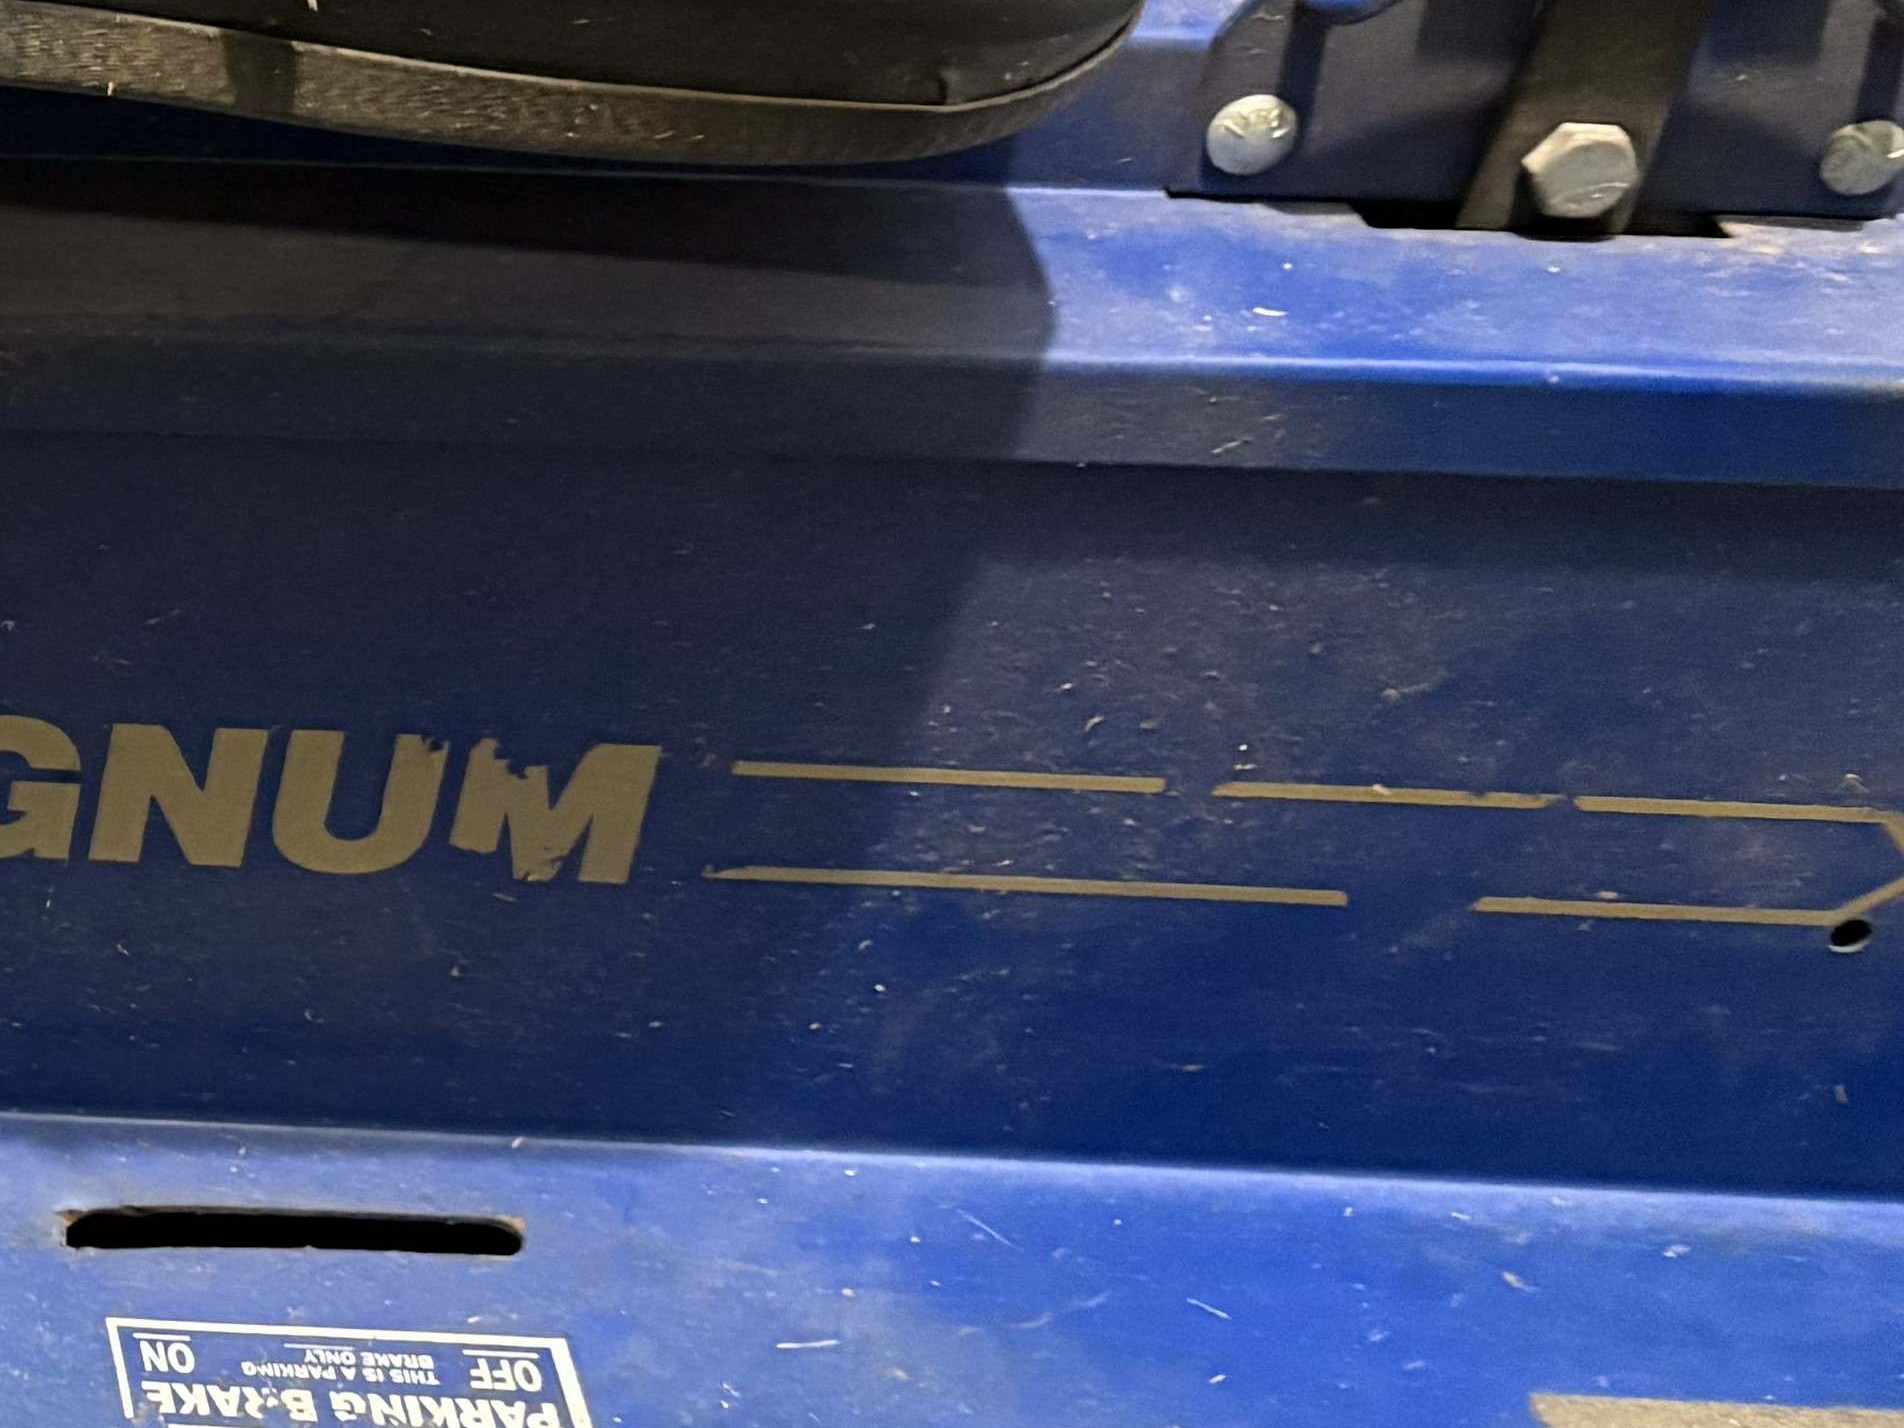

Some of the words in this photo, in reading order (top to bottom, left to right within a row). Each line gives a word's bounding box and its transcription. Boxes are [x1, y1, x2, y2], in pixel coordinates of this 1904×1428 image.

[140, 1340, 195, 1374] ON
[304, 1349, 357, 1365] ONLY
[360, 1351, 434, 1370] BRAKE
[241, 1361, 336, 1381] PARKING
[340, 1366, 356, 1381] A
[362, 1367, 384, 1383] IS
[390, 1369, 440, 1386] THIS
[470, 1359, 542, 1392] OFF
[140, 1380, 319, 1422] BRAKE
